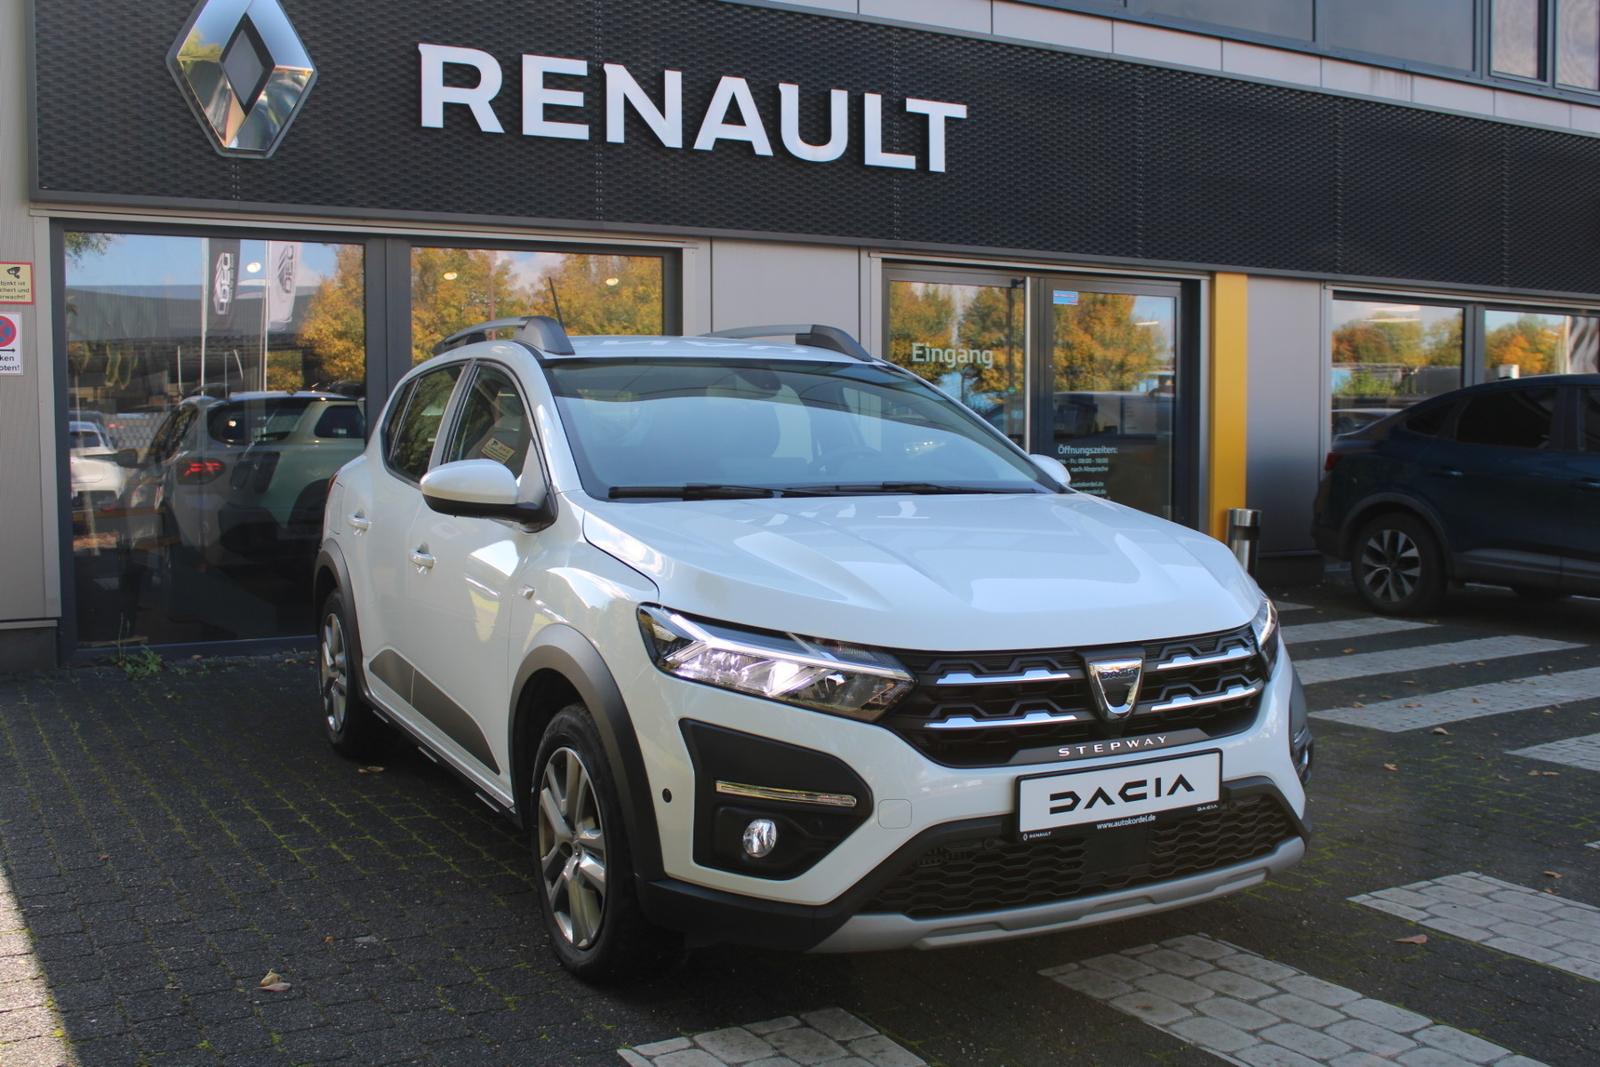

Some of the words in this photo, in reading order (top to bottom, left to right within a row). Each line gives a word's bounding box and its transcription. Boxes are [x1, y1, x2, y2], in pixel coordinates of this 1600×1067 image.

[418, 43, 967, 172] RENAULT
[911, 342, 993, 369] Eingang
[1058, 735, 1167, 757] STEPWAY
[1049, 774, 1195, 815] DACIA
[1096, 814, 1157, 830] www.autokordel.de
